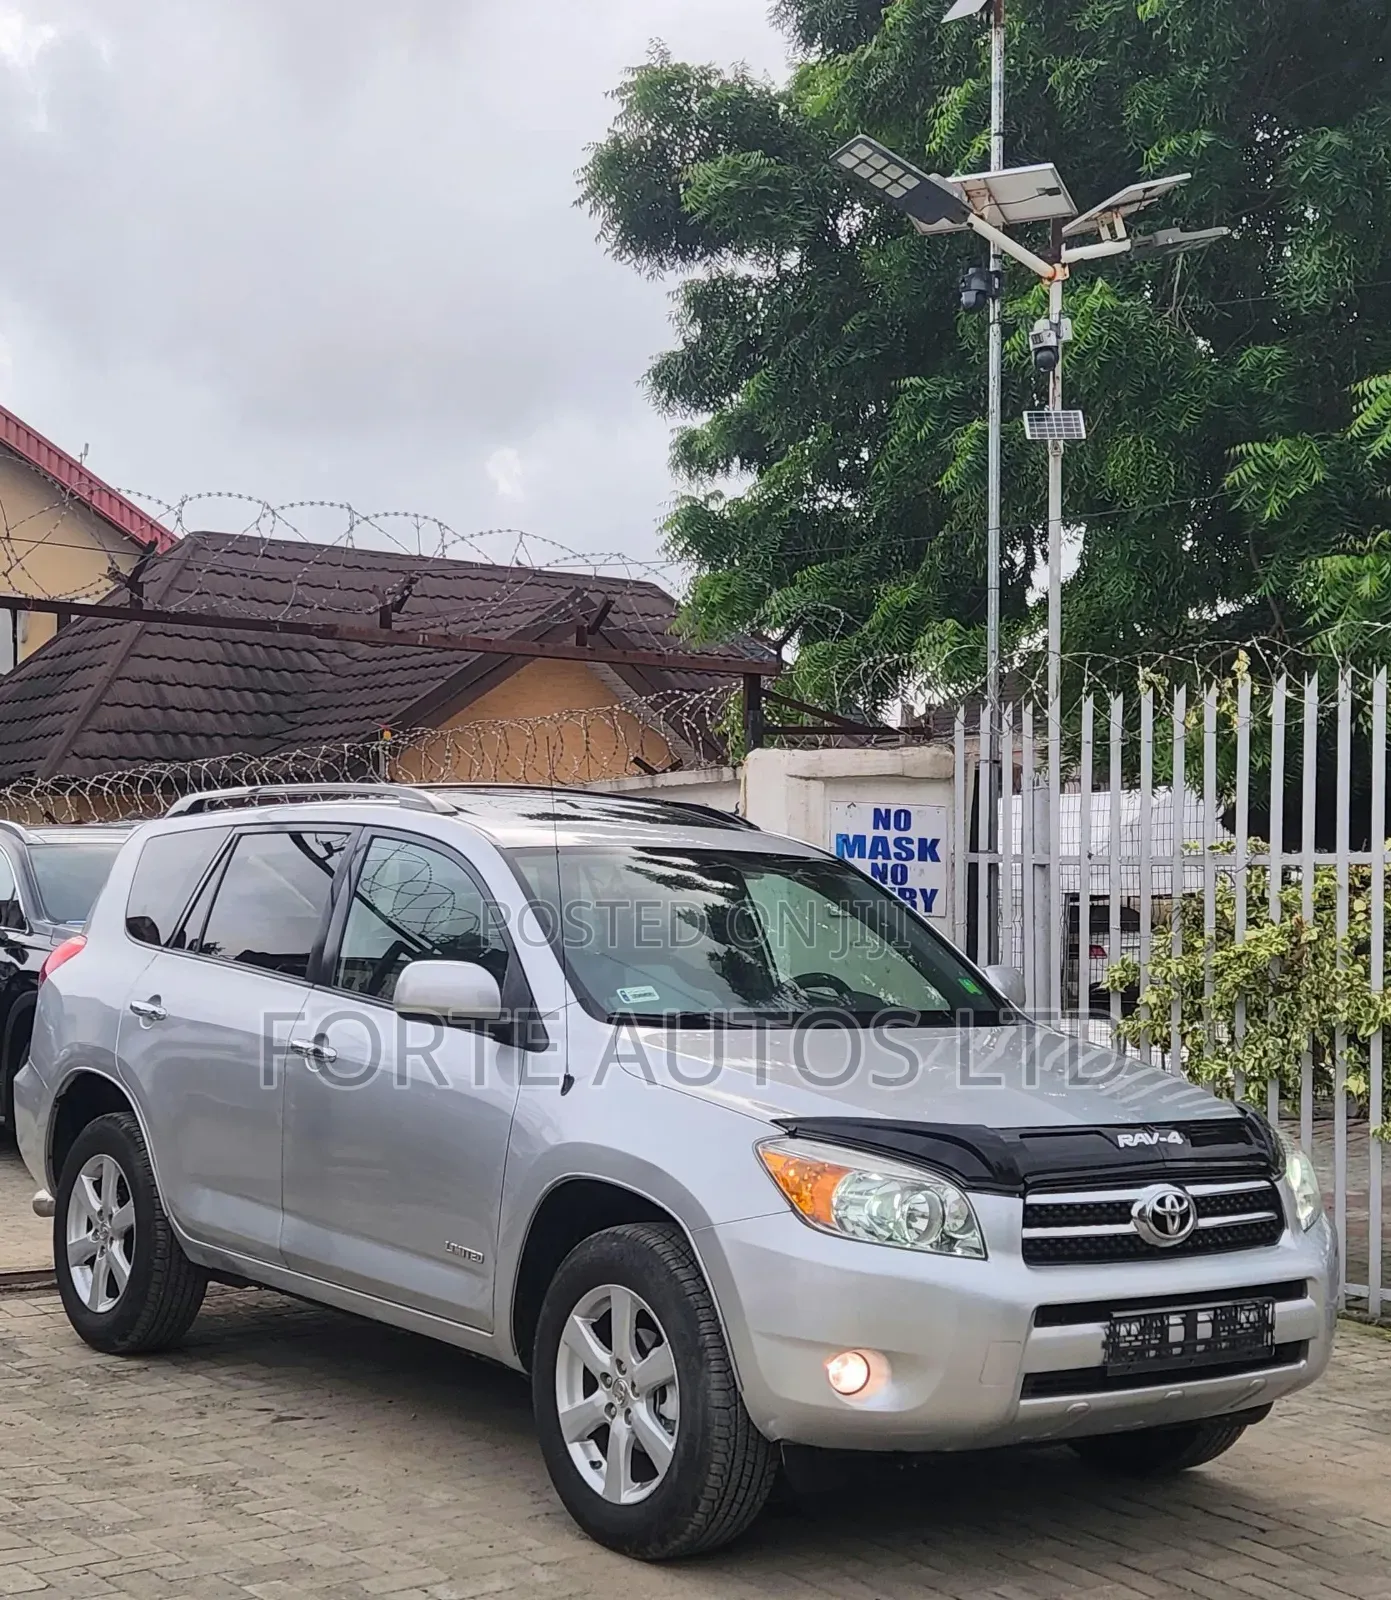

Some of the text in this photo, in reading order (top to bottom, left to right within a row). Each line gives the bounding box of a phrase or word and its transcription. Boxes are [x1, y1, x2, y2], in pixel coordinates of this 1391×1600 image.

[873, 808, 912, 832] NO
[835, 833, 941, 863] MASK
[870, 862, 909, 886] NO
[1117, 1131, 1184, 1148] RAV-4
